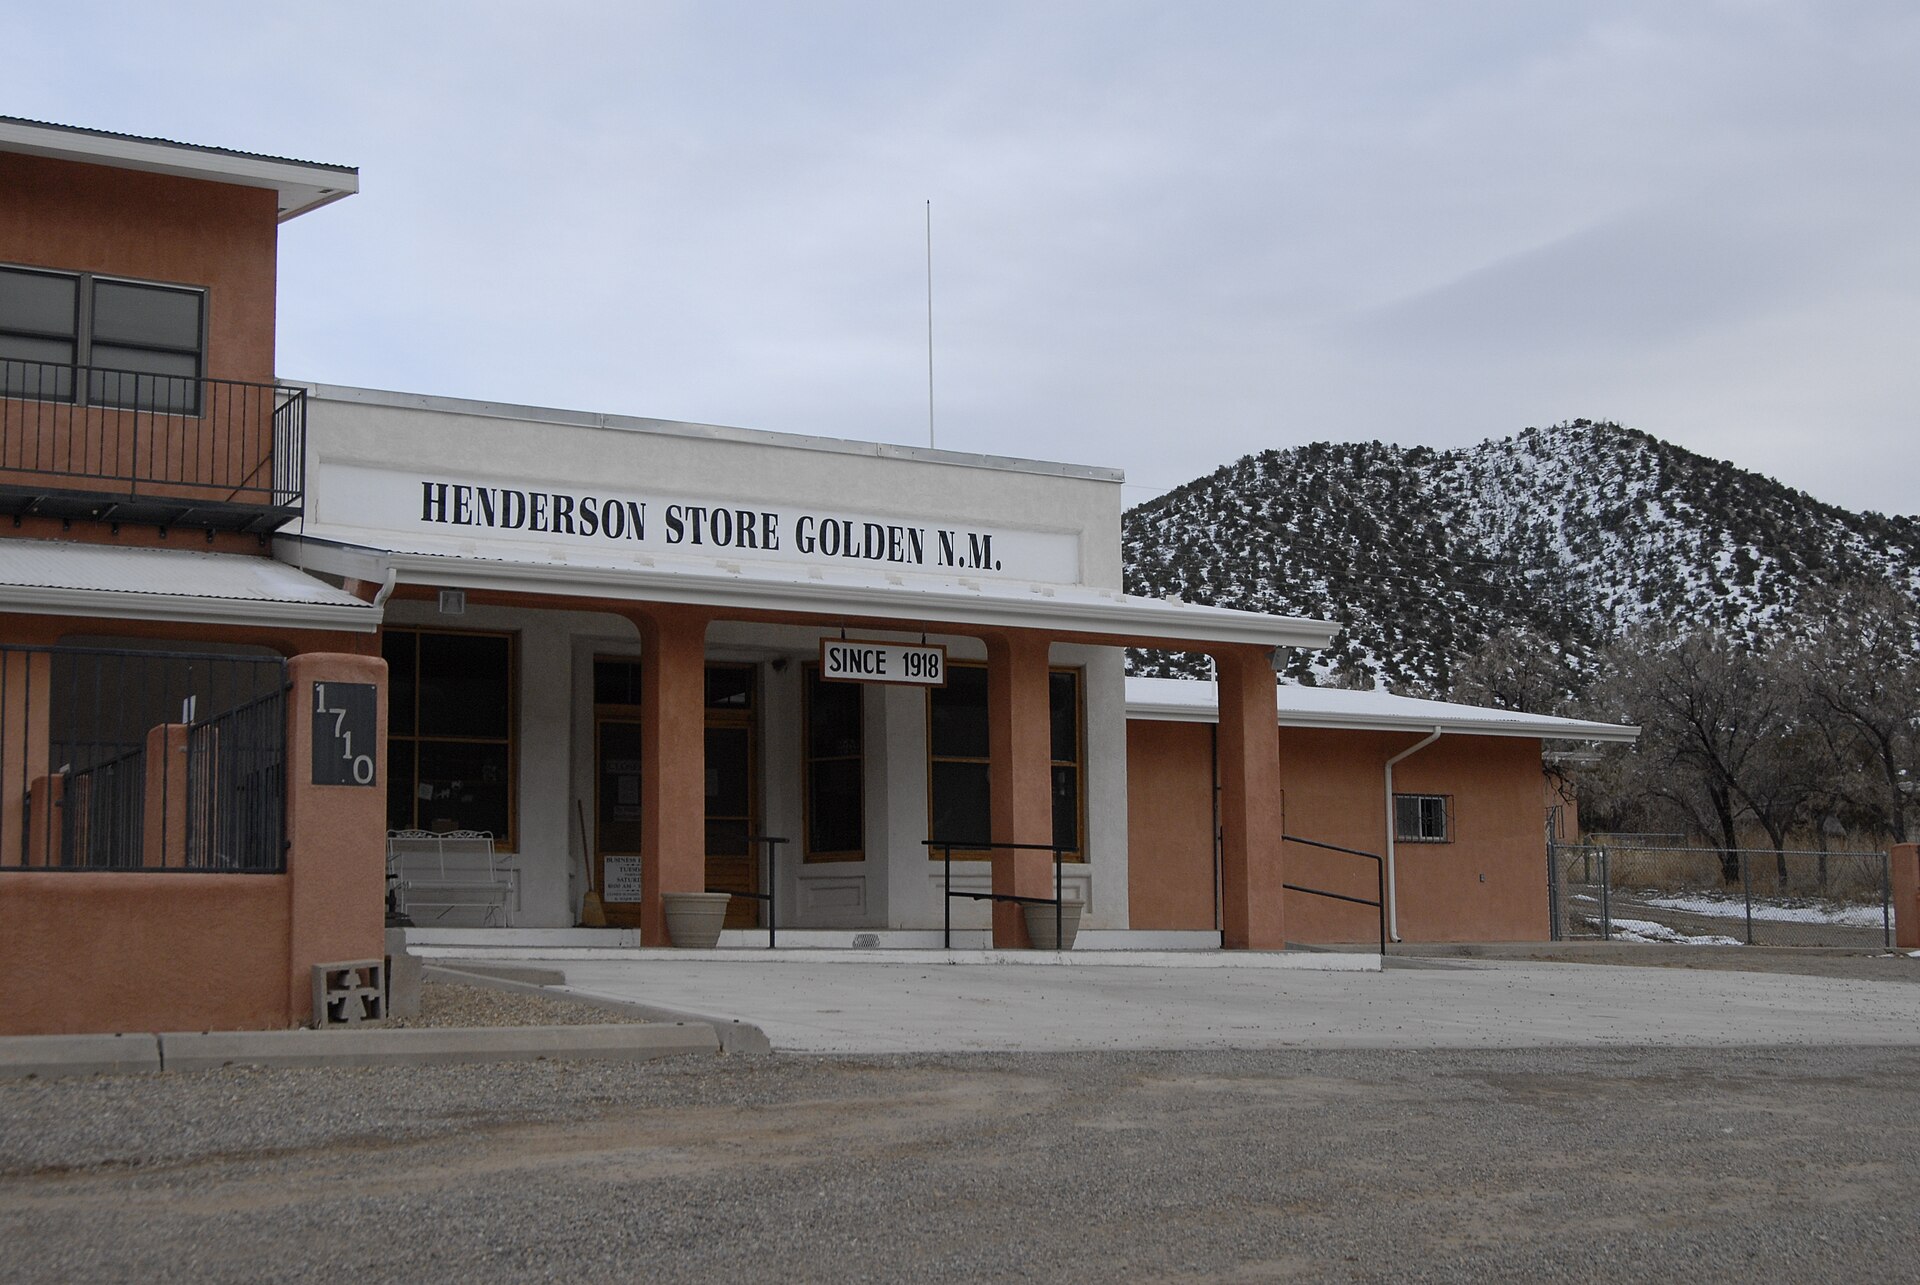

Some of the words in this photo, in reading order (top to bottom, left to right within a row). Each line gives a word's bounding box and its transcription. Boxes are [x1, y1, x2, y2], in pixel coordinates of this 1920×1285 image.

[421, 482, 646, 541] HENDERSON
[665, 505, 779, 551] STORE
[795, 516, 925, 565] GOLDEN
[937, 530, 1002, 572] N.M.
[829, 647, 886, 675] SINCE
[902, 652, 939, 678] 1918
[316, 684, 374, 785] 1710
